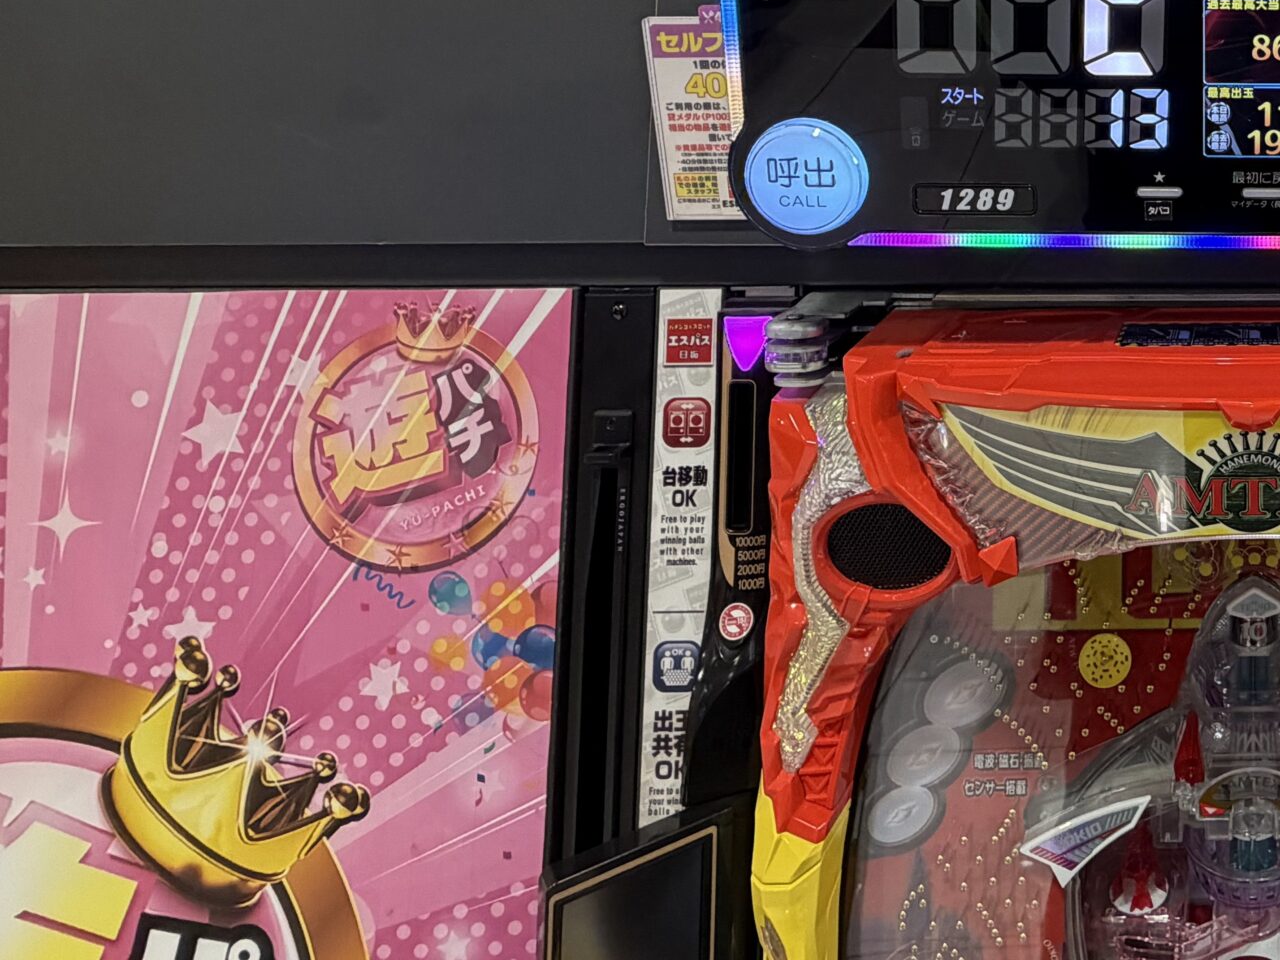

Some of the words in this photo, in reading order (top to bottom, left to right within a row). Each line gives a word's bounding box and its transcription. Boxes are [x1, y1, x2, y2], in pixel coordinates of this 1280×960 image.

[941, 87, 984, 104] スタート
[1207, 87, 1254, 99] 最高出玉
[941, 109, 985, 129] ゲーム
[766, 156, 836, 189] 呼出
[778, 193, 828, 208] CALL
[940, 188, 1016, 211] 1289
[1147, 205, 1171, 215] タバコ
[668, 332, 711, 346] エスパス
[662, 465, 708, 487] 台移動
[671, 489, 697, 507] OK
[399, 483, 489, 534] YU-PACHI
[660, 514, 678, 523] Free
[680, 515, 687, 524] to
[689, 515, 706, 525] play
[660, 525, 680, 534] with
[684, 526, 705, 536] your
[689, 536, 705, 544] balls
[735, 535, 767, 547] 10000円
[659, 546, 678, 556] with
[681, 547, 704, 556] other
[737, 548, 766, 562] 5000円
[737, 563, 765, 576] 2000円
[738, 577, 765, 590] 1000円
[672, 648, 685, 656] OK
[964, 780, 1027, 796] センサー搭載
